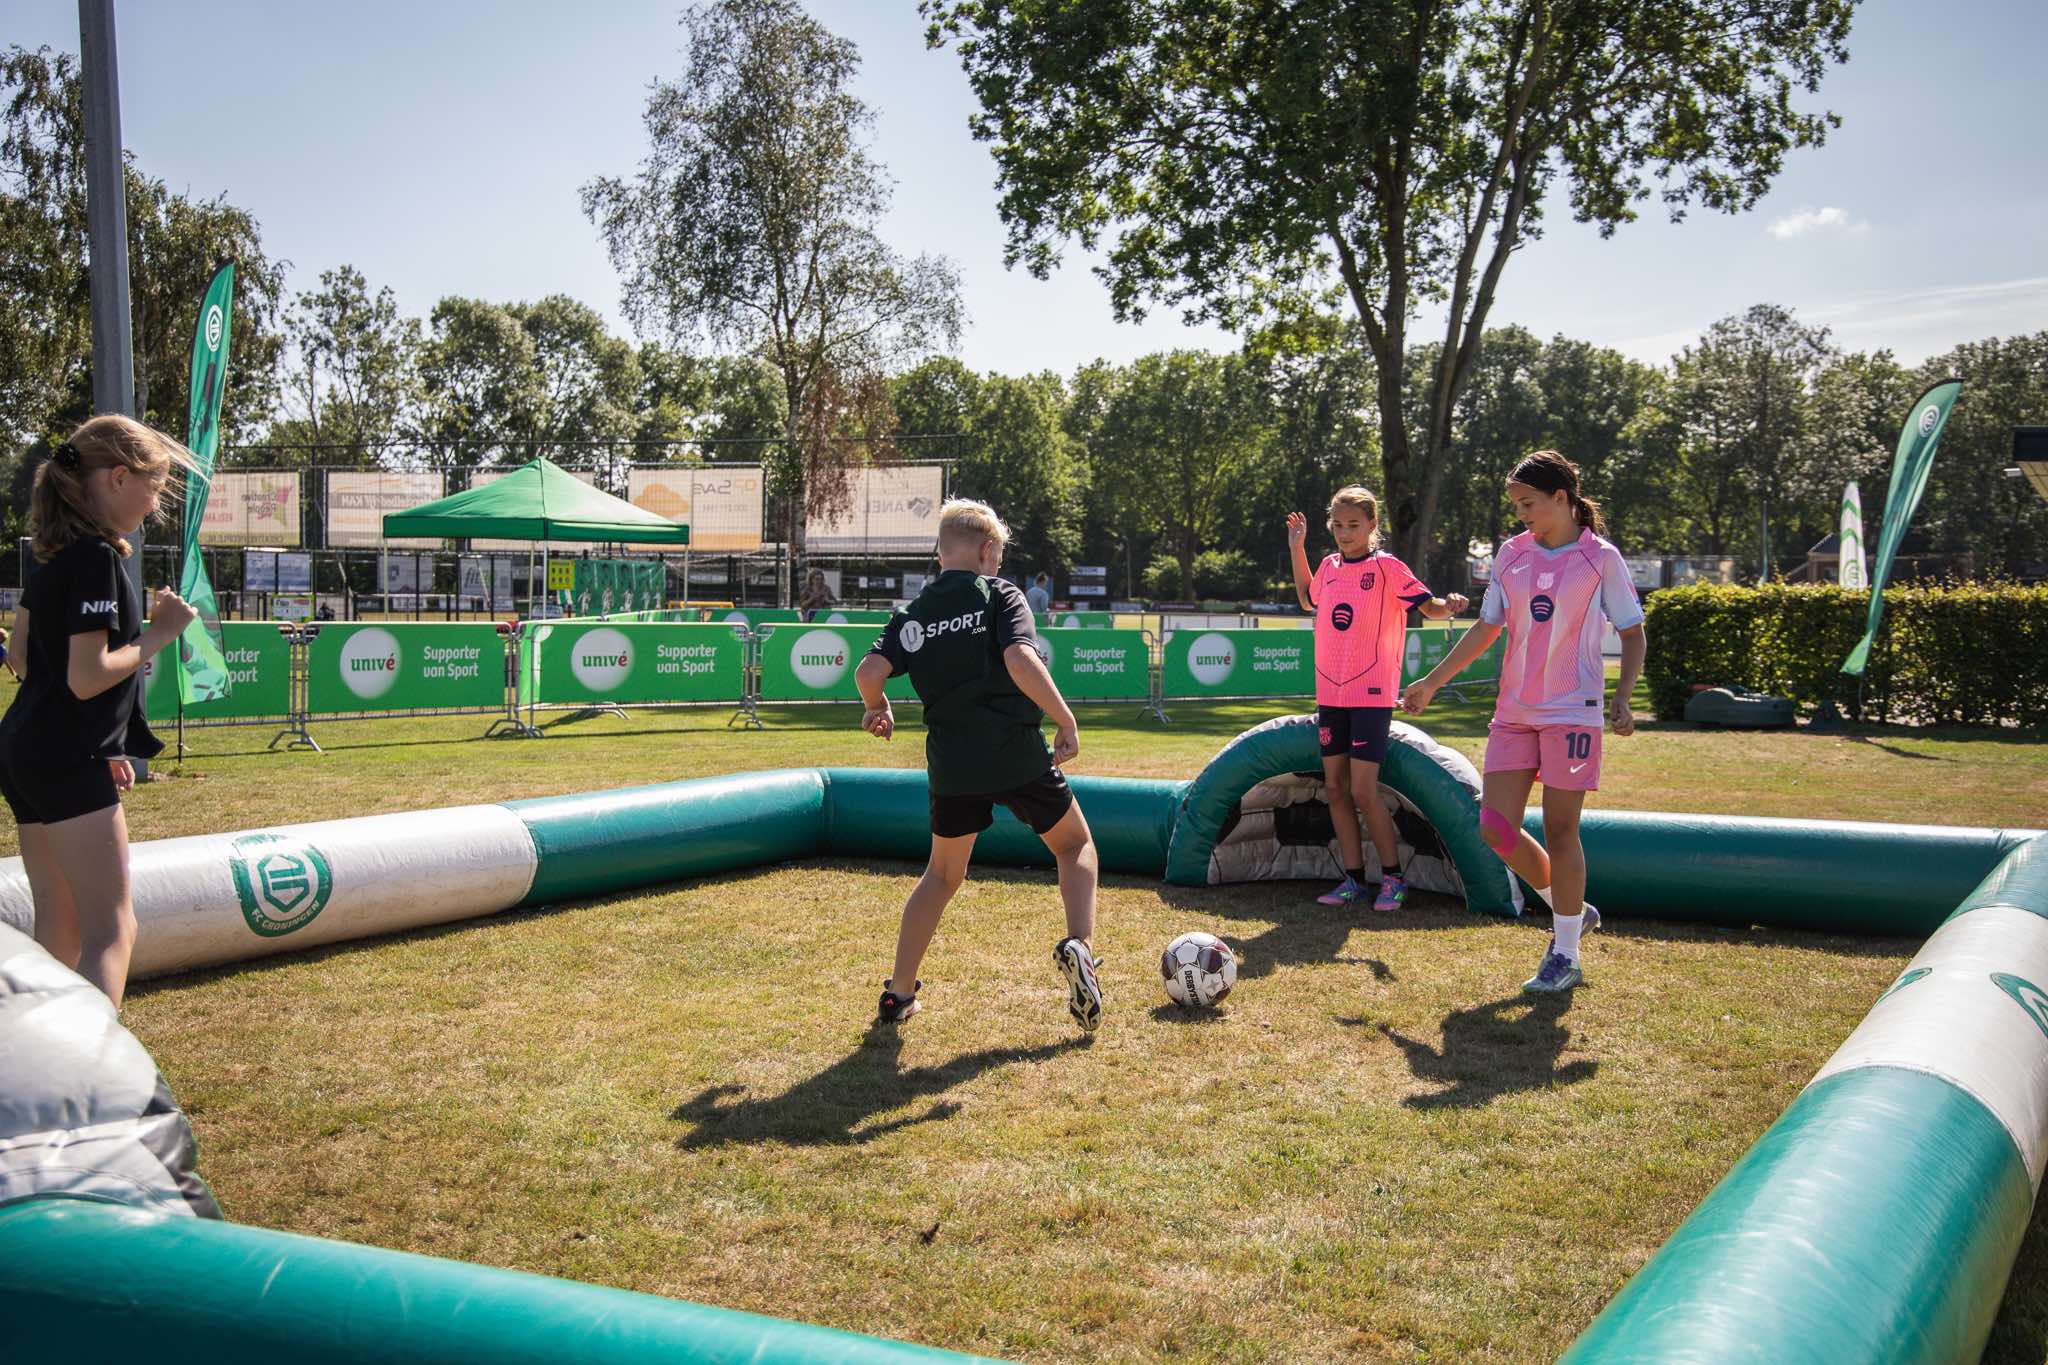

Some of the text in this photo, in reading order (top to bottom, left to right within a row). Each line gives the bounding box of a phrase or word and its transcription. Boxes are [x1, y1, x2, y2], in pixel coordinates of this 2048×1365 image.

[81, 601, 118, 614] NIK
[424, 643, 480, 663] Supporter
[582, 650, 628, 667] univé
[657, 643, 718, 661] Supporter
[800, 651, 844, 666] univé
[1073, 647, 1126, 661] Supporter
[1195, 651, 1232, 665] univé
[1253, 646, 1301, 660] Supporter
[351, 653, 396, 671] univé
[657, 659, 716, 676] van Sport
[1073, 661, 1126, 675] van Sport
[1253, 660, 1300, 672] van Sport
[229, 667, 258, 683] port
[424, 662, 479, 681] van Sport
[1565, 732, 1592, 760] 10
